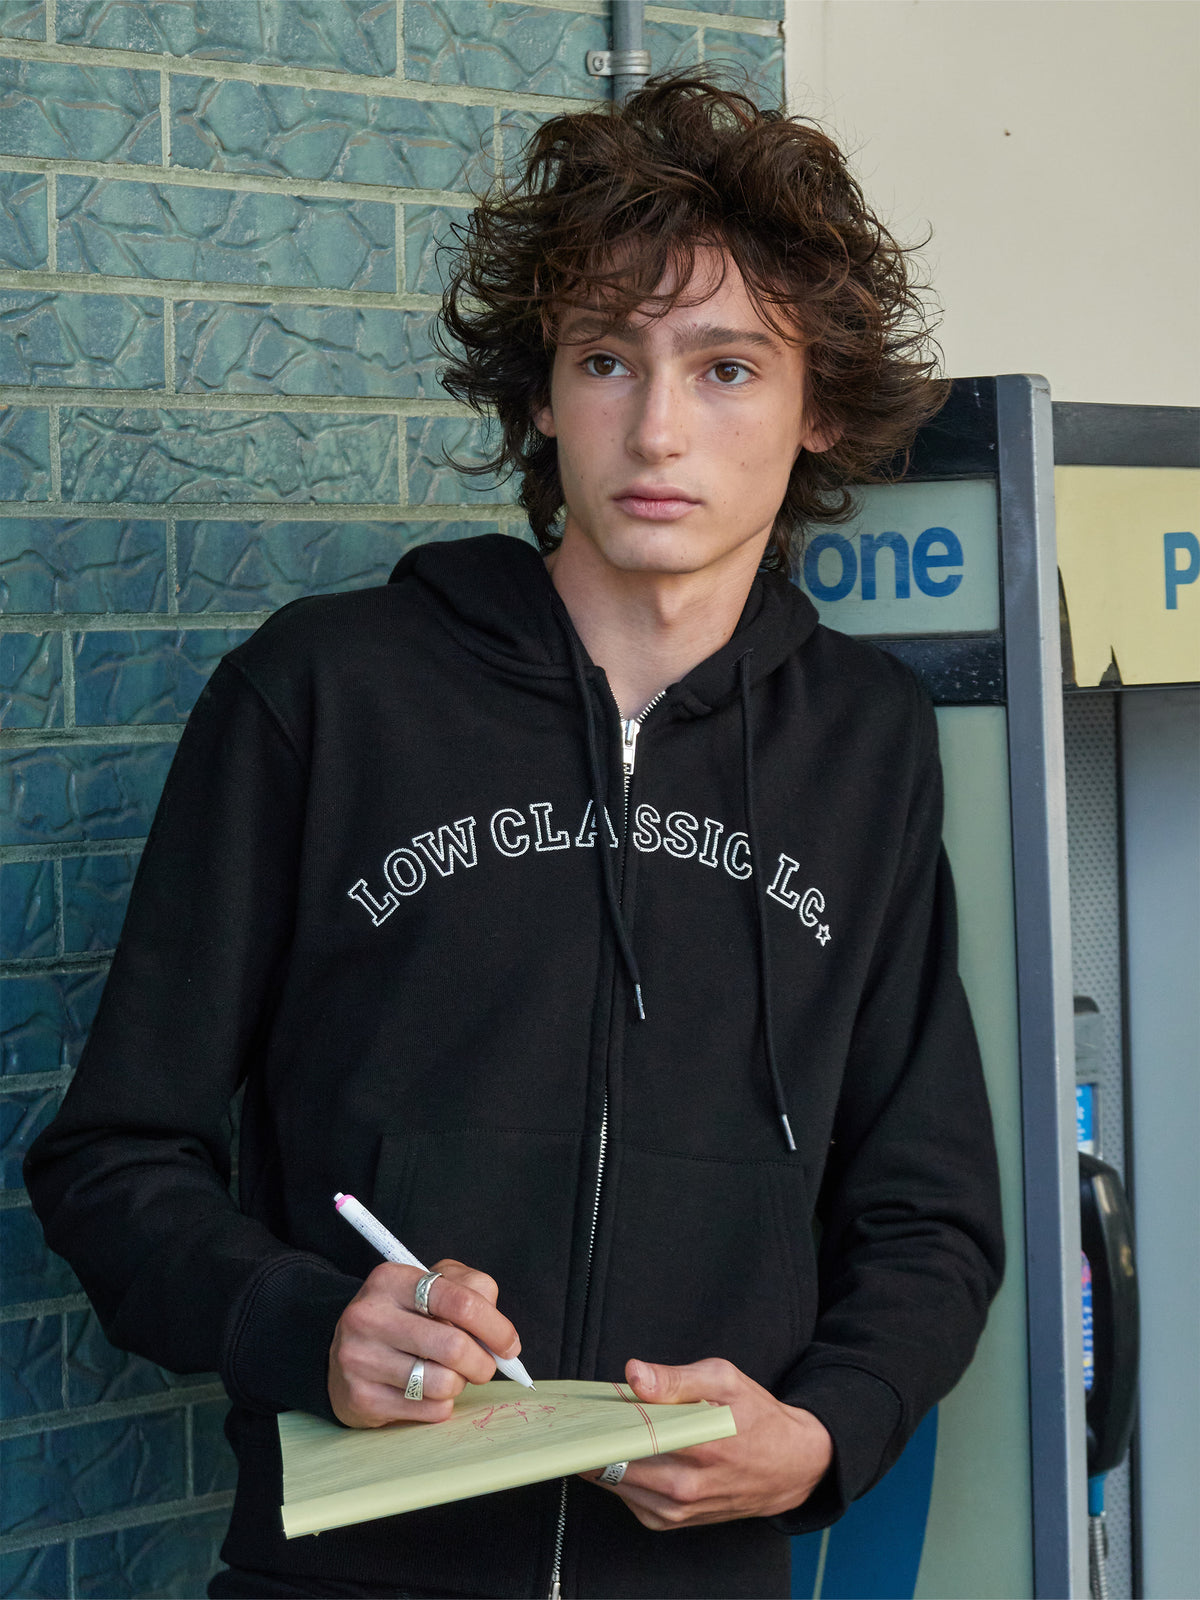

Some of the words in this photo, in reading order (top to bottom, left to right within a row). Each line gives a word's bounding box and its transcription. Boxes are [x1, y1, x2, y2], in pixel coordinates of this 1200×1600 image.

[789, 527, 964, 602] one
[348, 816, 477, 927] LOW
[490, 799, 753, 880] CLASSIC
